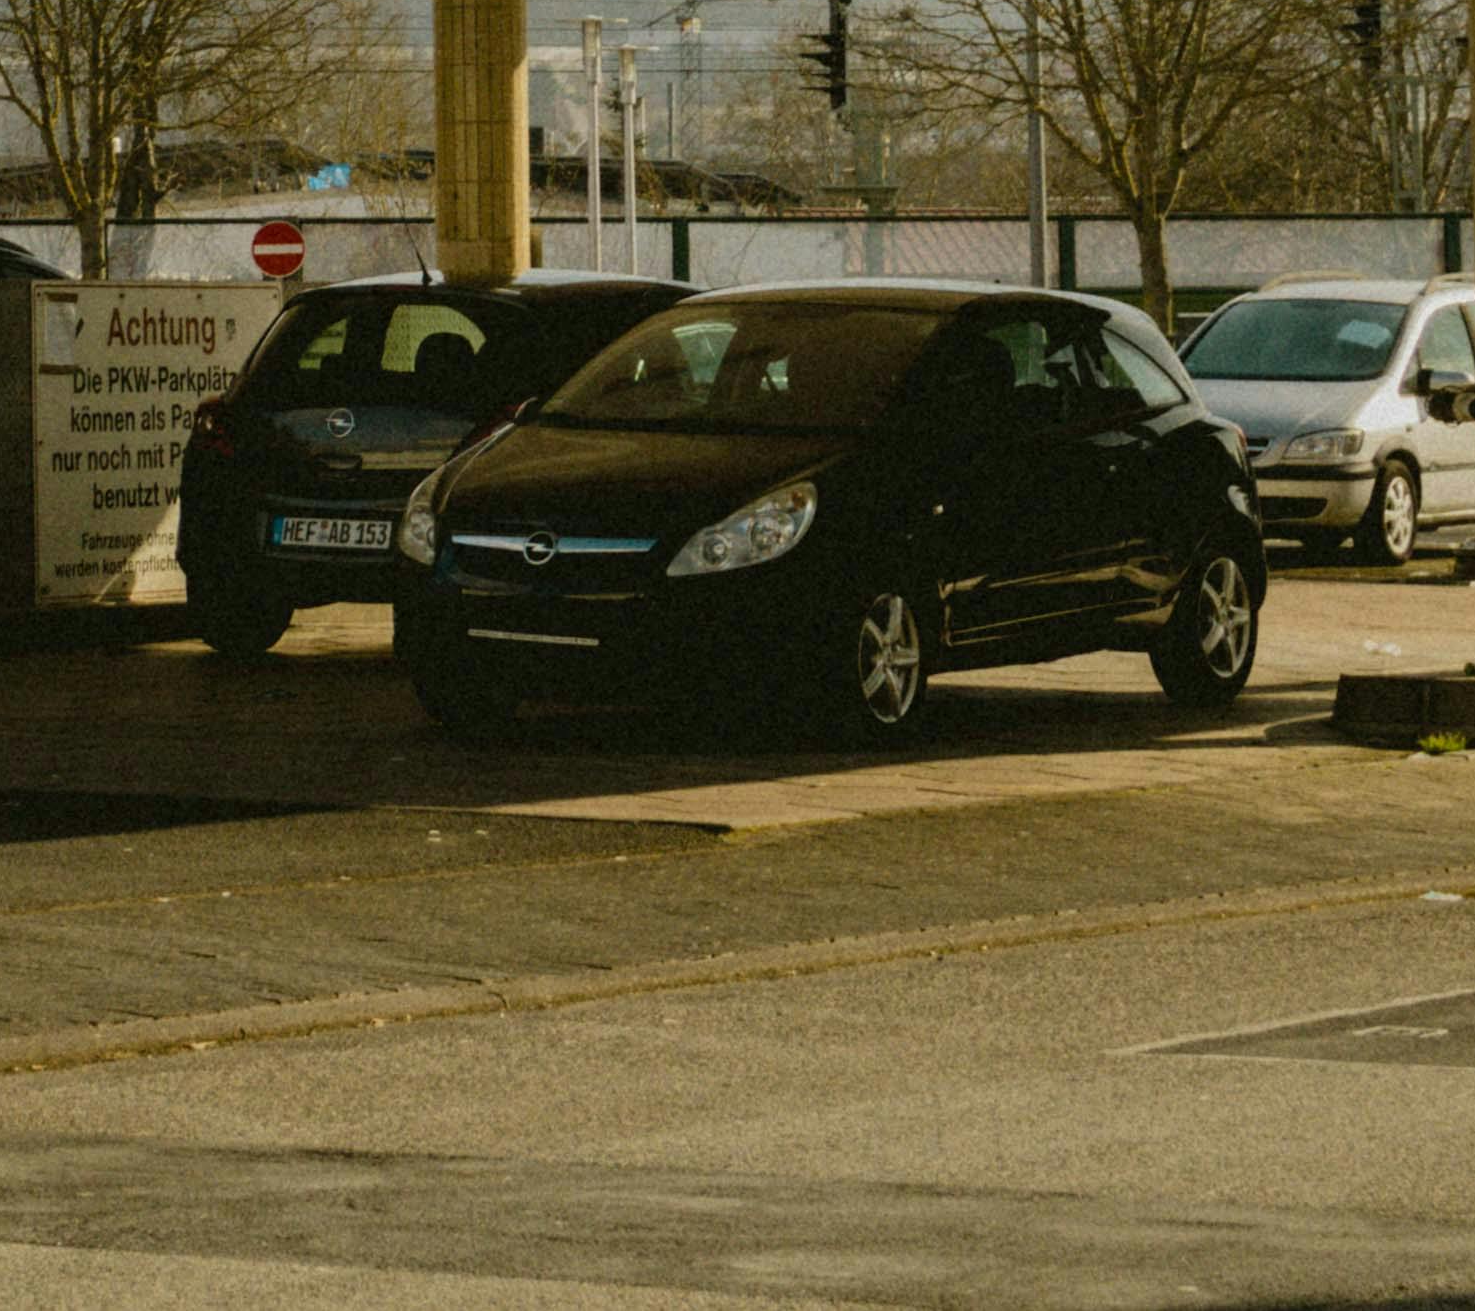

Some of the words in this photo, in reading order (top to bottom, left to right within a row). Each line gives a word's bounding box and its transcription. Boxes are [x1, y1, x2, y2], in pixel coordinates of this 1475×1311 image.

[107, 308, 216, 354] Achtung
[73, 368, 102, 393] Die
[70, 406, 136, 433] können
[140, 405, 166, 431] als
[52, 451, 82, 471] nur
[87, 444, 131, 470] noch
[137, 443, 164, 468] mit
[92, 482, 159, 509] benutzt
[81, 533, 143, 551] Fahrzeuge
[145, 532, 175, 547] ohne
[283, 520, 317, 542] HEF
[328, 522, 351, 543] AB
[355, 523, 388, 545] 153
[54, 559, 99, 577] werden
[102, 556, 180, 577] kostenpflicht
